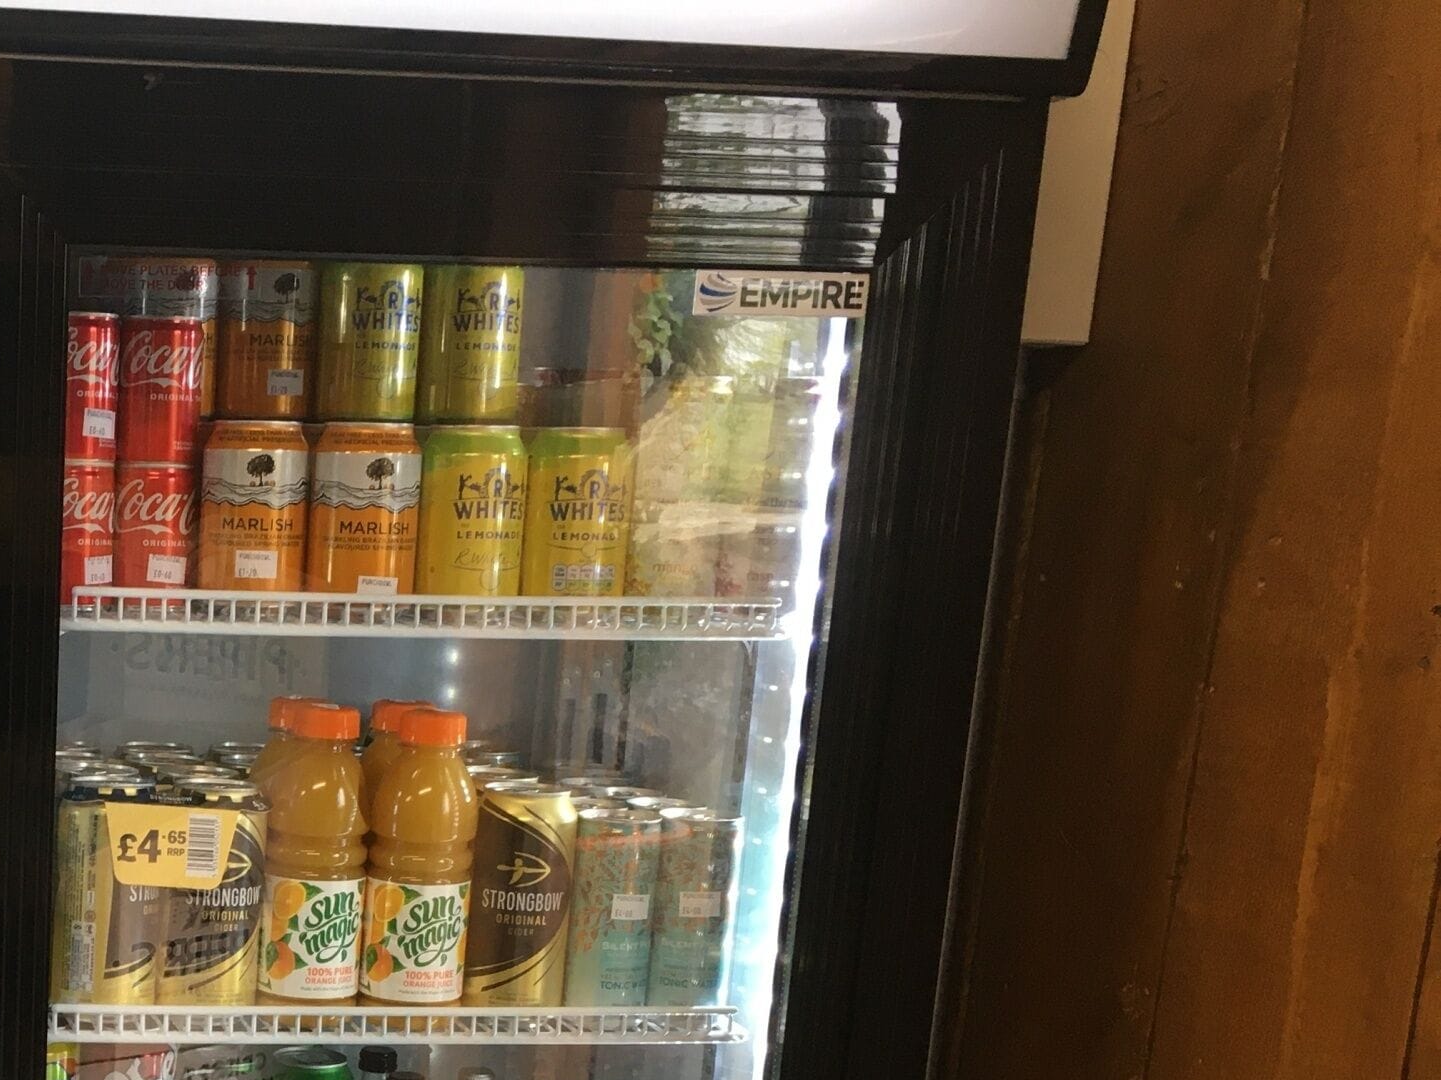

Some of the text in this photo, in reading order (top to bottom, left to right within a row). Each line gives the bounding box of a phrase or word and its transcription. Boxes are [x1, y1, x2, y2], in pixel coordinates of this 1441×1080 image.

[388, 292, 399, 309] R
[489, 293, 500, 310] R
[740, 280, 863, 310] EMPIRE
[353, 312, 420, 333] WHITES
[454, 314, 520, 335] WHITES
[494, 479, 503, 497] R
[589, 480, 601, 499] R
[453, 501, 524, 521] WHITES
[550, 501, 626, 522] WHITES
[222, 516, 294, 531] MARLISH
[340, 520, 409, 535] MARLISH
[142, 538, 187, 548] ORIGINAL
[166, 847, 185, 857] RRP
[186, 885, 261, 907] STRONGBOW
[481, 888, 564, 912] STRONGBOW
[201, 910, 249, 921] ORIGINAL
[305, 891, 359, 929] sun
[403, 895, 462, 932] sun
[496, 913, 547, 926] ORIGINAL
[299, 912, 360, 963] magic
[397, 916, 461, 967] magic
[307, 966, 353, 976] 100% PURE
[405, 970, 454, 980] 100% PURE
[304, 976, 337, 985] ORANGE
[403, 980, 435, 988] ORANGE
